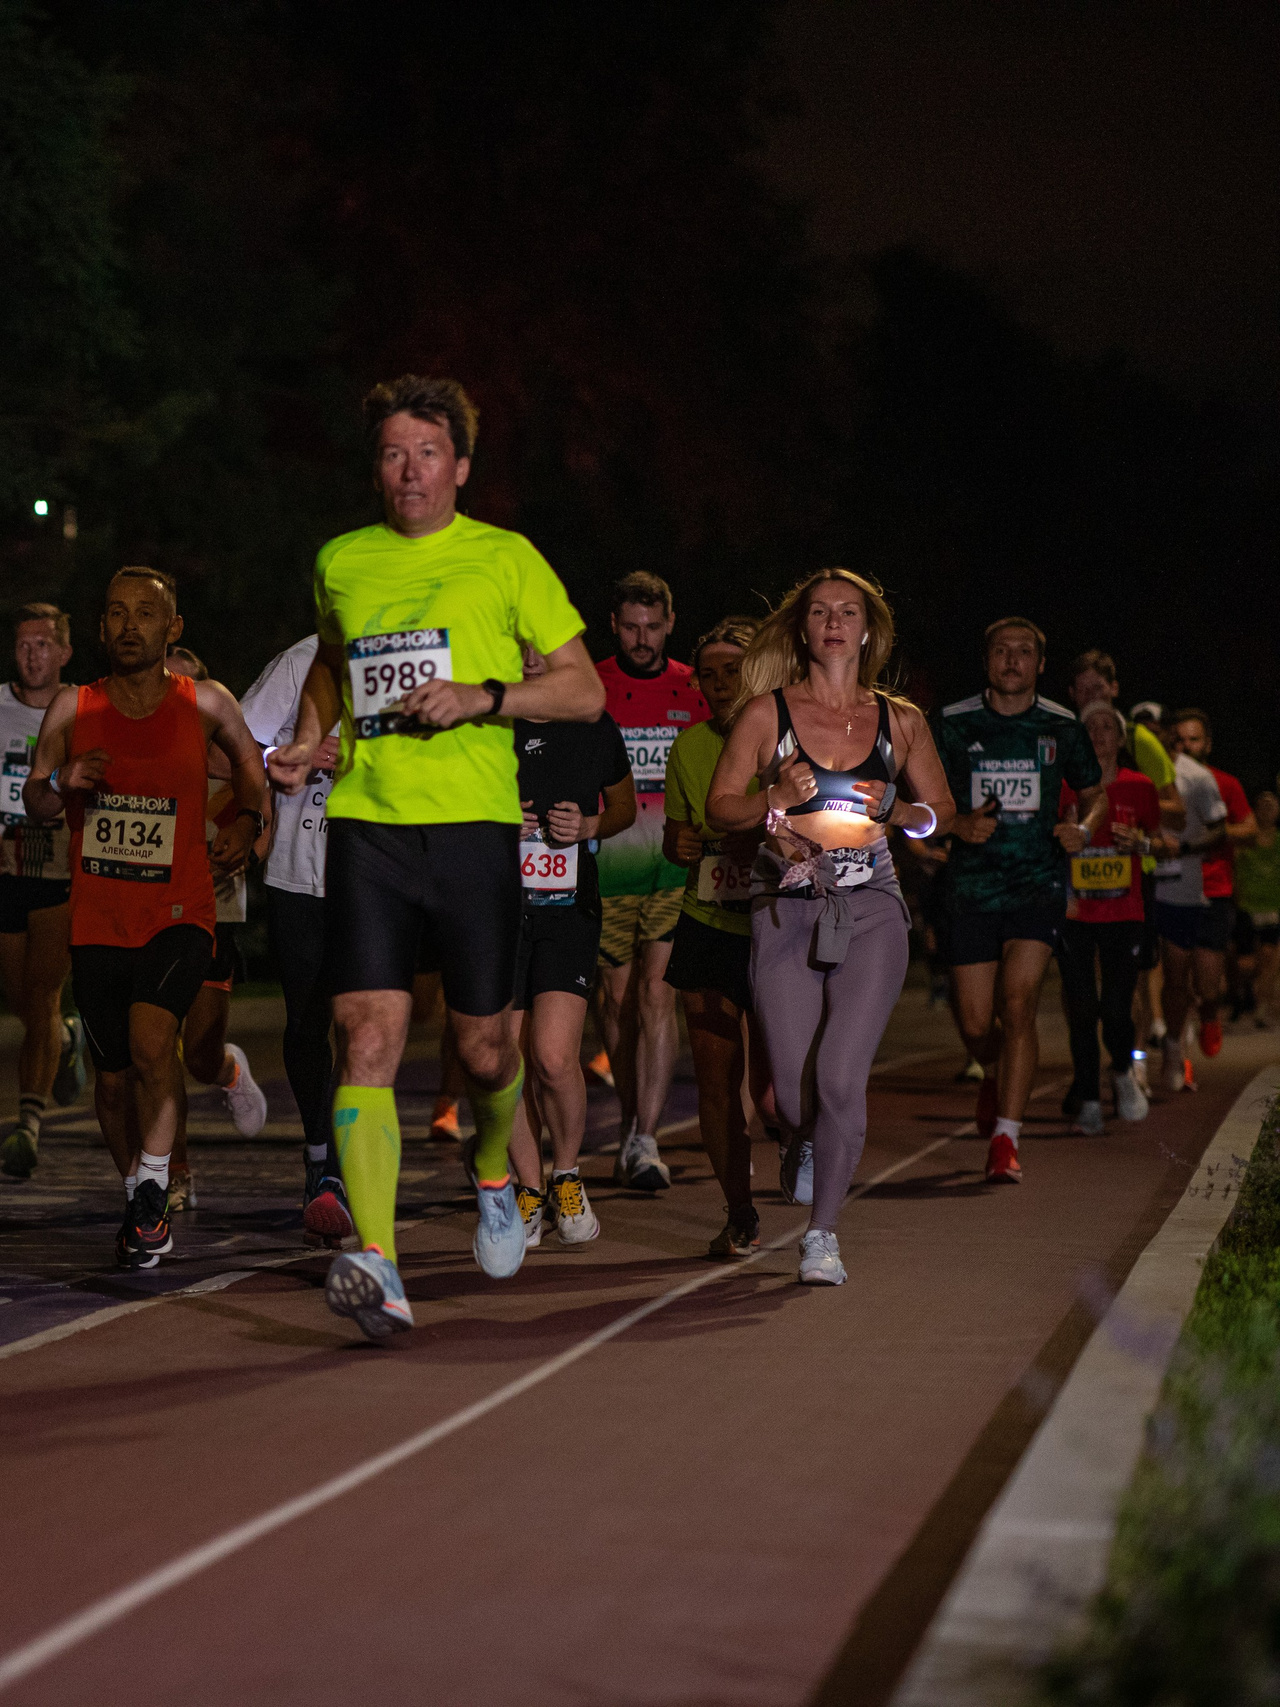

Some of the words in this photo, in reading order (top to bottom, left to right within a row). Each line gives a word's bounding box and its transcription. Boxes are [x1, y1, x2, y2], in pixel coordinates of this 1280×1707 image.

[363, 659, 437, 696] 5989
[980, 778, 1032, 798] 5075
[823, 800, 853, 812] NIKE
[95, 817, 164, 849] 8134
[101, 846, 154, 859] АЛЕКСАНДР
[521, 852, 567, 878] 638
[710, 863, 752, 890] 965
